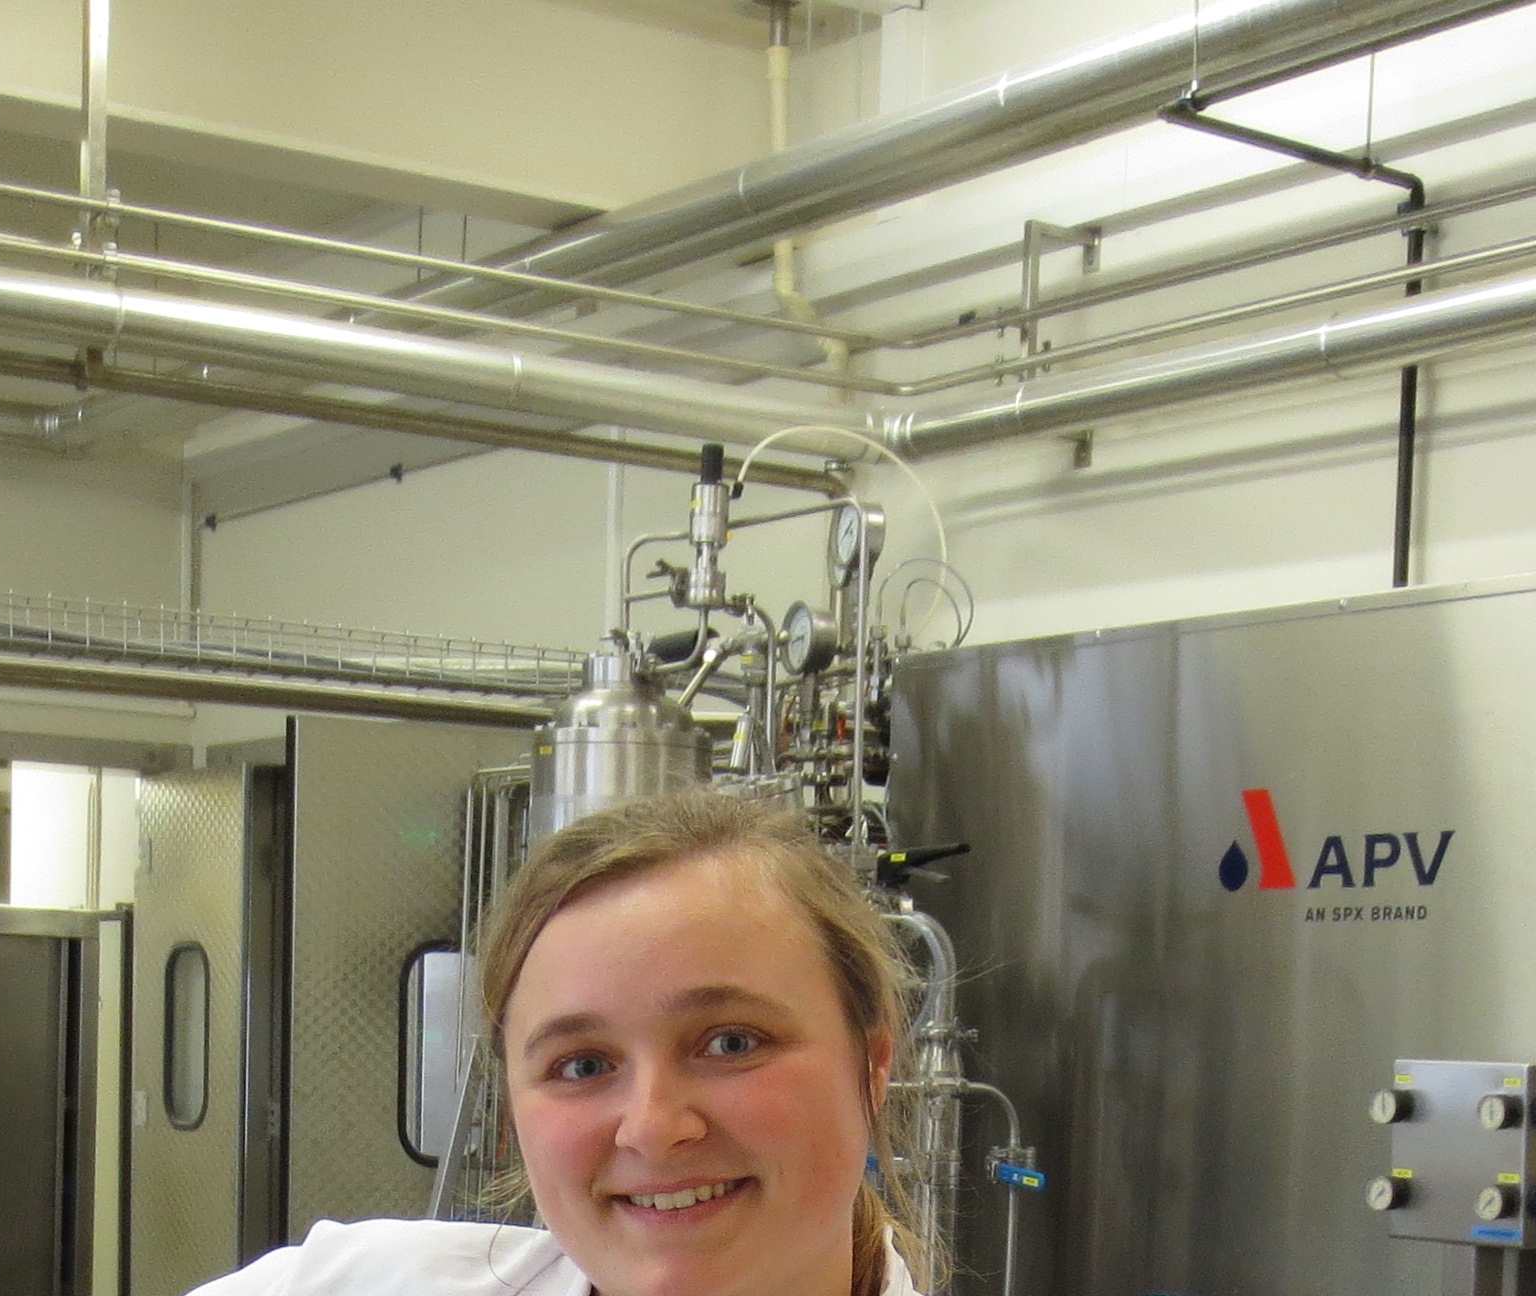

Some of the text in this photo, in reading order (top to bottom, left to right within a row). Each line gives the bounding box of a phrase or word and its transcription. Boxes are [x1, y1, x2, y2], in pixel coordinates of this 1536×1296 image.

[1307, 830, 1456, 889] APV
[1304, 905, 1427, 922] AN SPX BRAND
